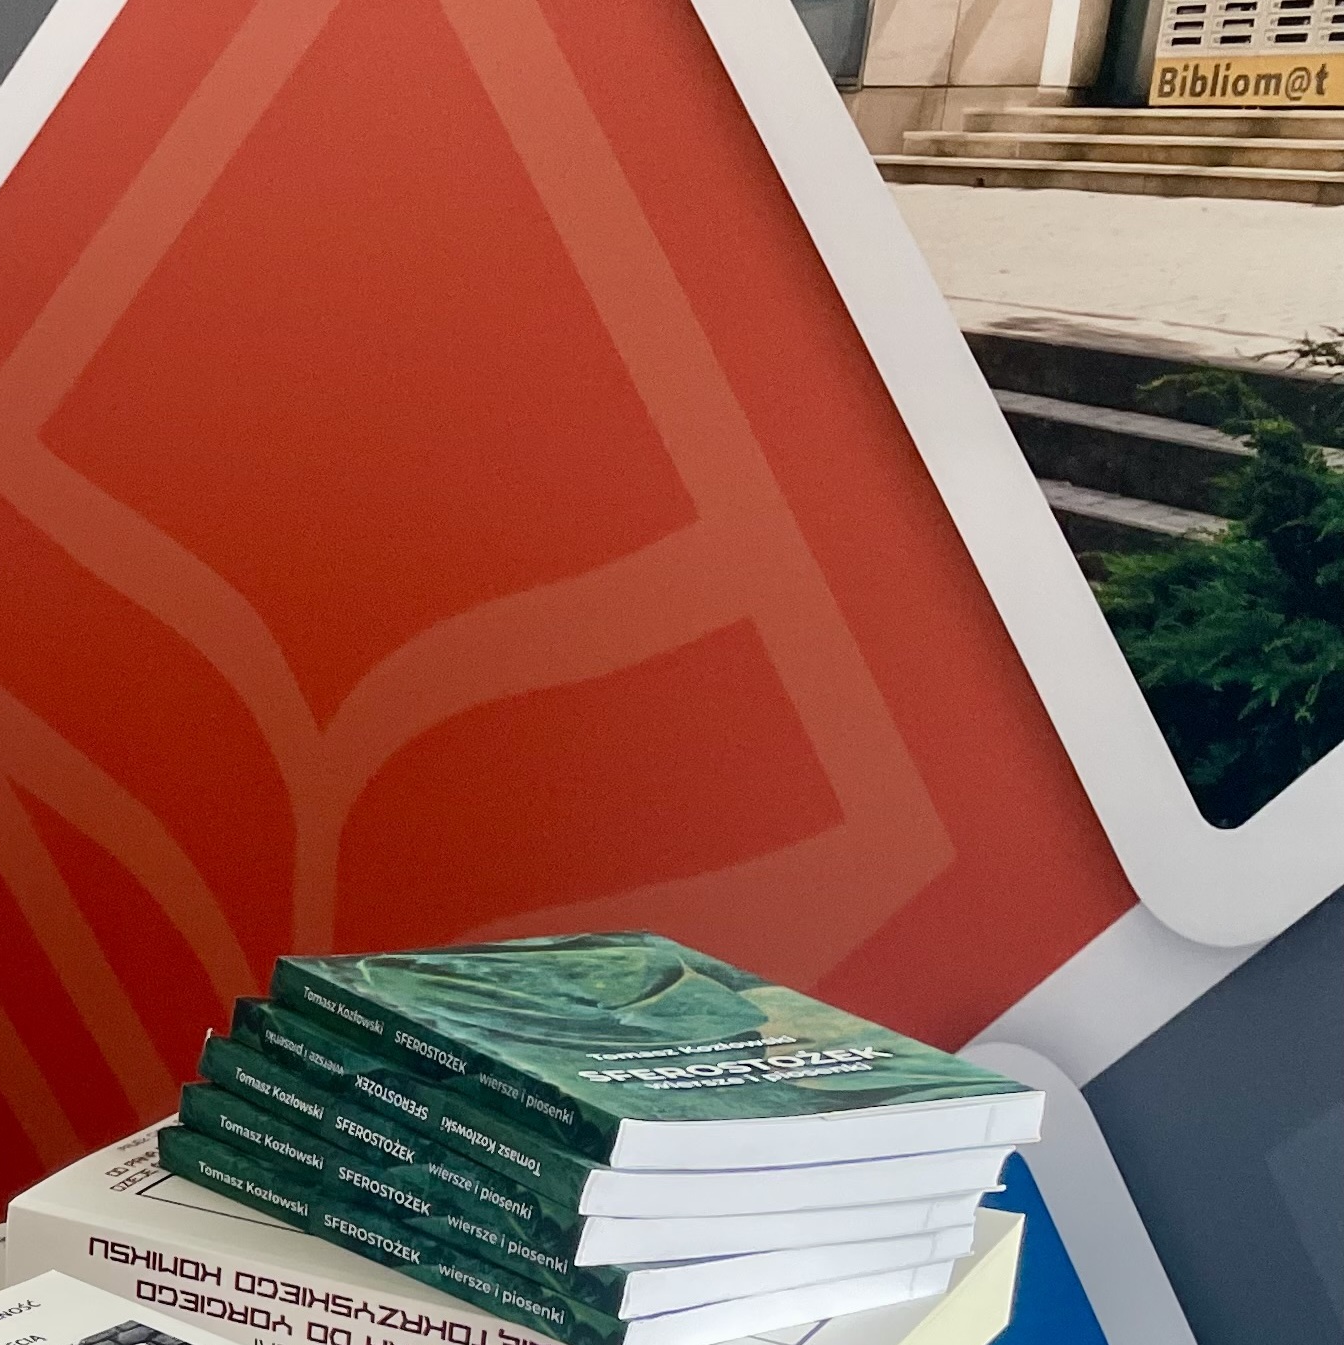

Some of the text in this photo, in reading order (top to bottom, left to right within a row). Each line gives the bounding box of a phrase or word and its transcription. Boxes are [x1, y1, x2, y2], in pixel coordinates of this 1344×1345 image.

[1157, 62, 1329, 101] Bibliom@t
[264, 1028, 543, 1177] Tomasz Kozłowski SFEROSTOŻEK wiersze piosenki
[302, 985, 337, 1015] Tomasz
[335, 999, 385, 1036] Kozłowski
[393, 1029, 468, 1075] SFEROSTOŻEK
[478, 1070, 520, 1101] wiersze
[525, 1089, 575, 1126] piosenki
[578, 1045, 894, 1083] SFEROSTOŻEK
[218, 1113, 262, 1144] Tomasz
[263, 1130, 325, 1171] Kozłowski
[337, 1165, 432, 1218] SFEROSTOŻEK
[446, 1213, 499, 1247] wiersze
[506, 1236, 569, 1276] piosenki
[234, 1066, 272, 1096] Tomasz
[271, 1082, 325, 1121] Kozłowski
[334, 1115, 416, 1165] SFEROSTOŻEK
[427, 1160, 474, 1192] wiersze
[480, 1182, 533, 1221] piosenki
[87, 1235, 223, 1286] KOMIKSU
[197, 1160, 245, 1192] Tomasz
[244, 1177, 309, 1218] Kozłowski
[323, 1213, 422, 1266] SFEROSTOŻEK
[437, 1261, 493, 1296] wiersze
[500, 1285, 566, 1327] piosenki
